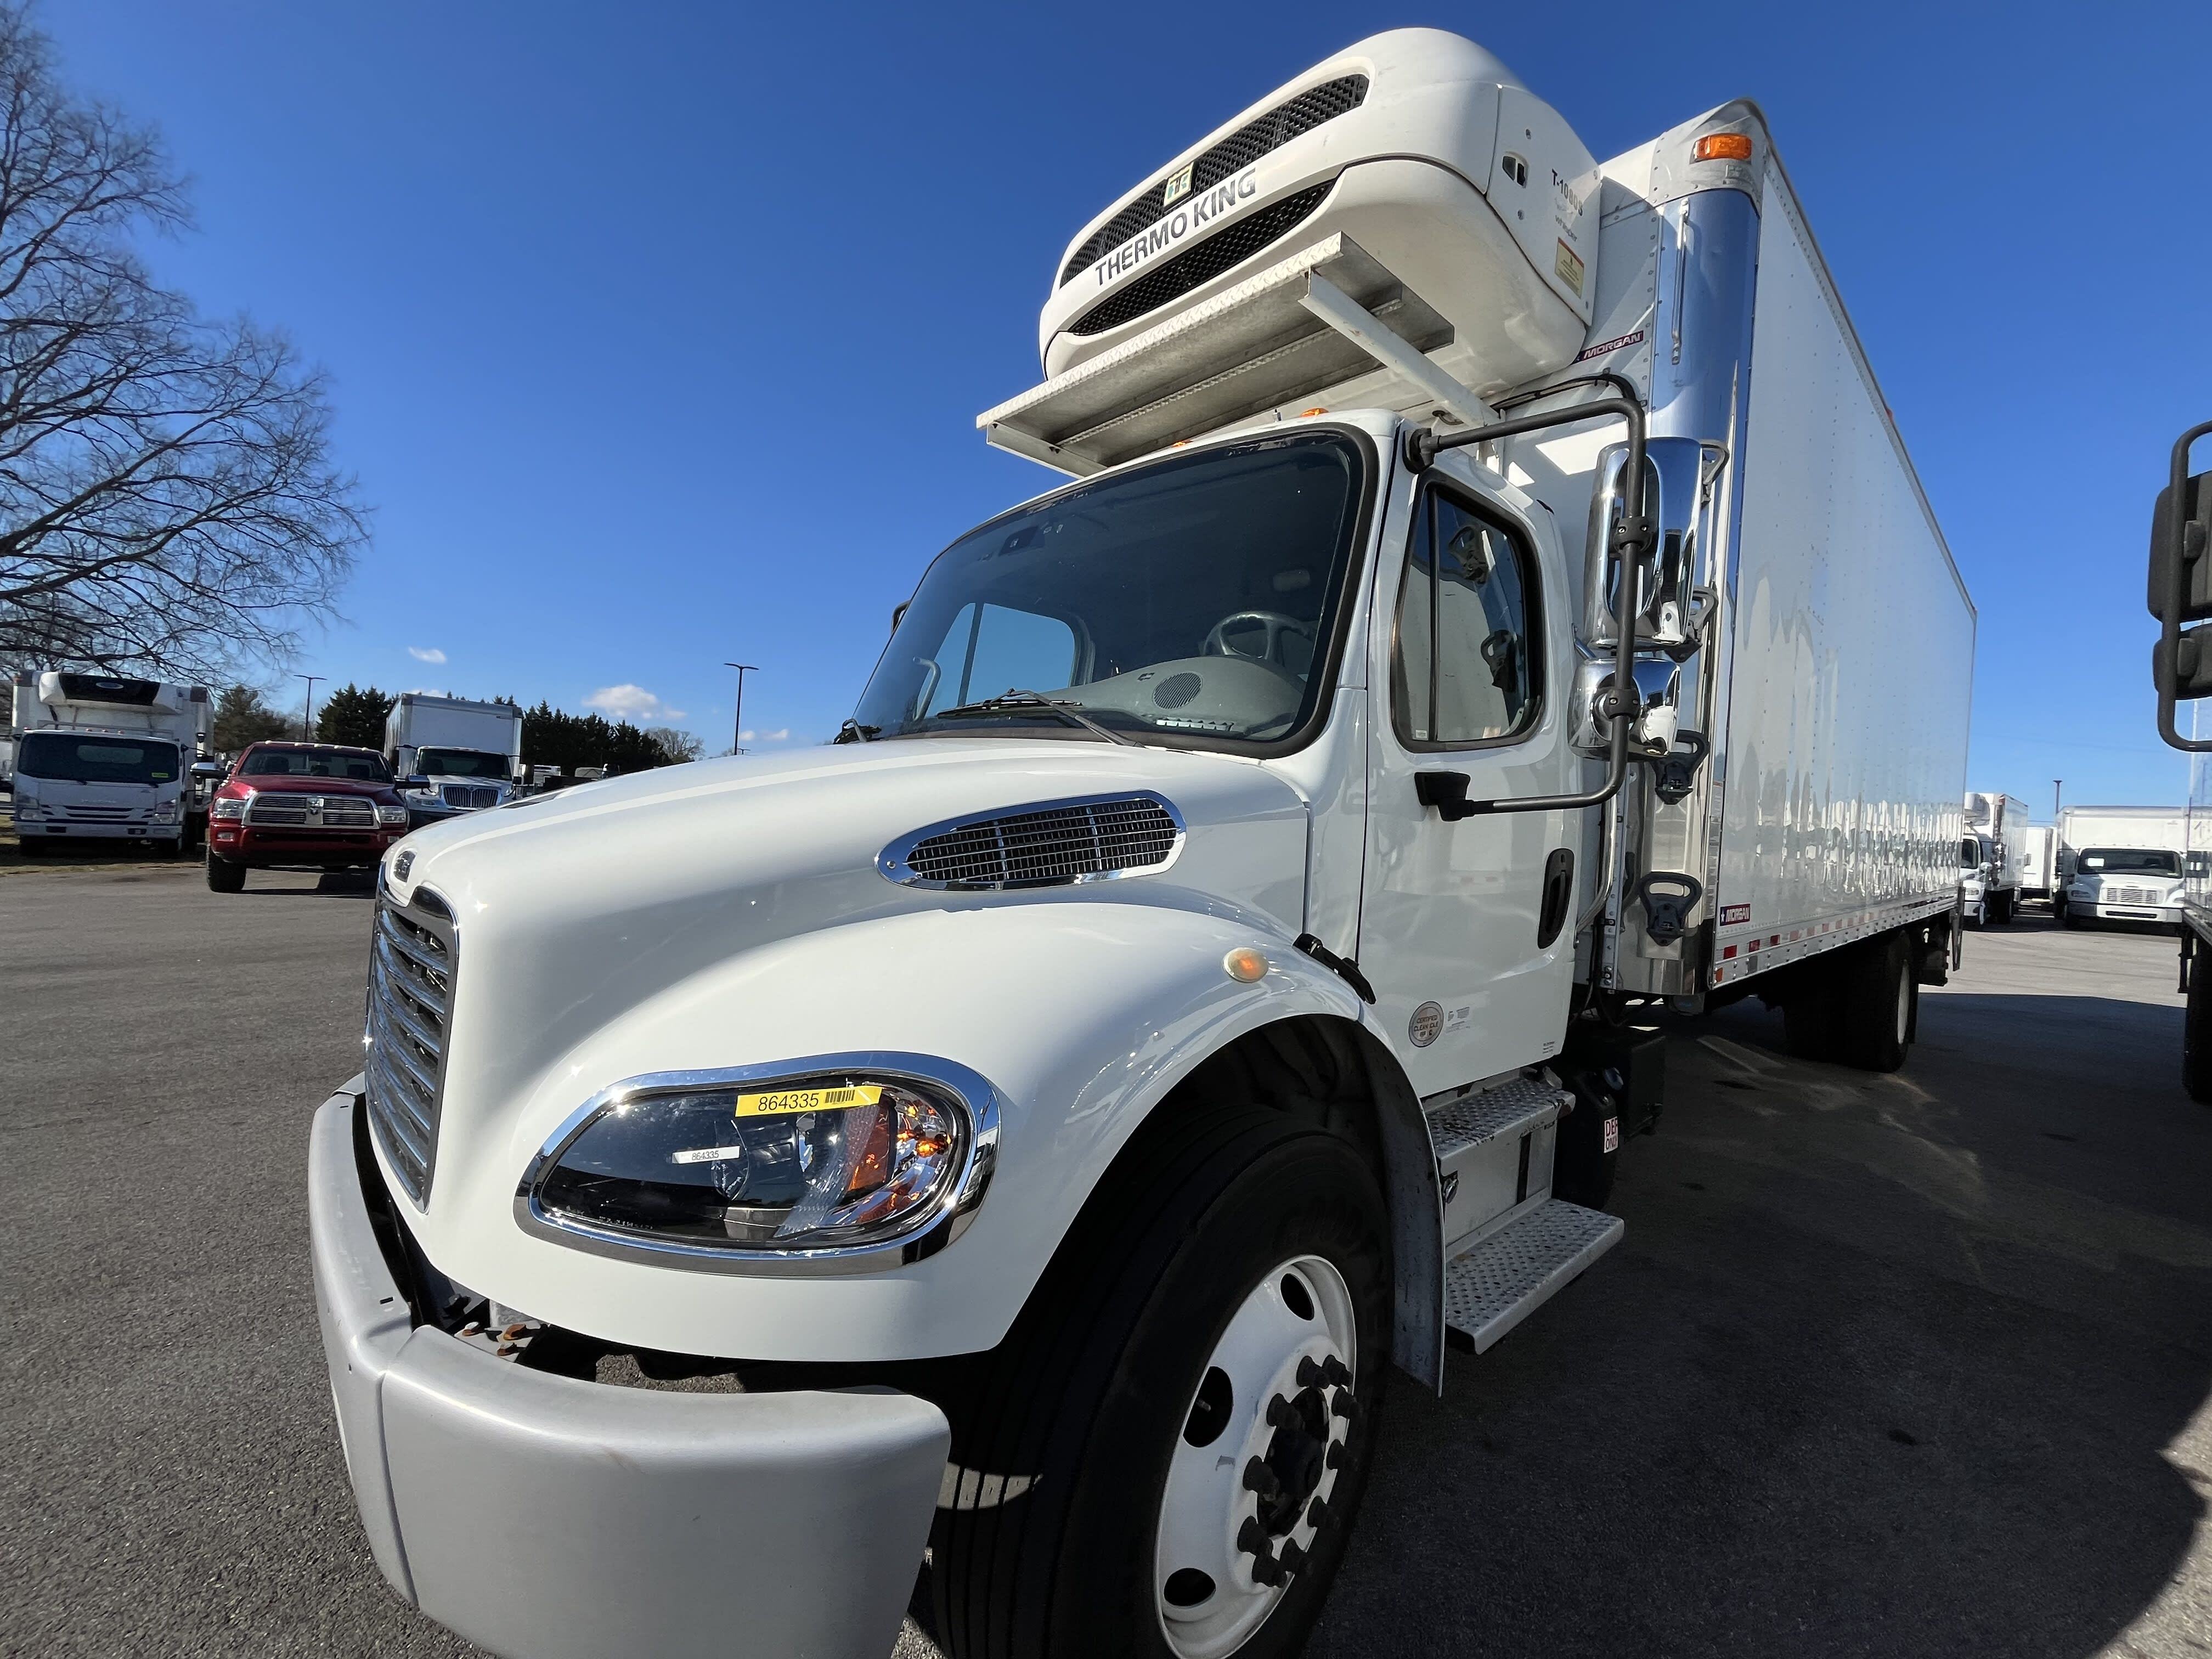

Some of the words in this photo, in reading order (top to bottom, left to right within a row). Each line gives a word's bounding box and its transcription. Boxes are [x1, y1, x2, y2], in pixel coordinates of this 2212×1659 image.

[1095, 212, 1188, 286] THERMO
[1194, 167, 1256, 228] KING
[1583, 332, 1640, 359] MORGAN
[1725, 907, 1750, 922] MORGAN
[1414, 1024, 1428, 1032] CLEAN
[758, 1093, 819, 1111] 864335
[1606, 1118, 1618, 1137] DEF
[692, 1150, 719, 1160] 864335
